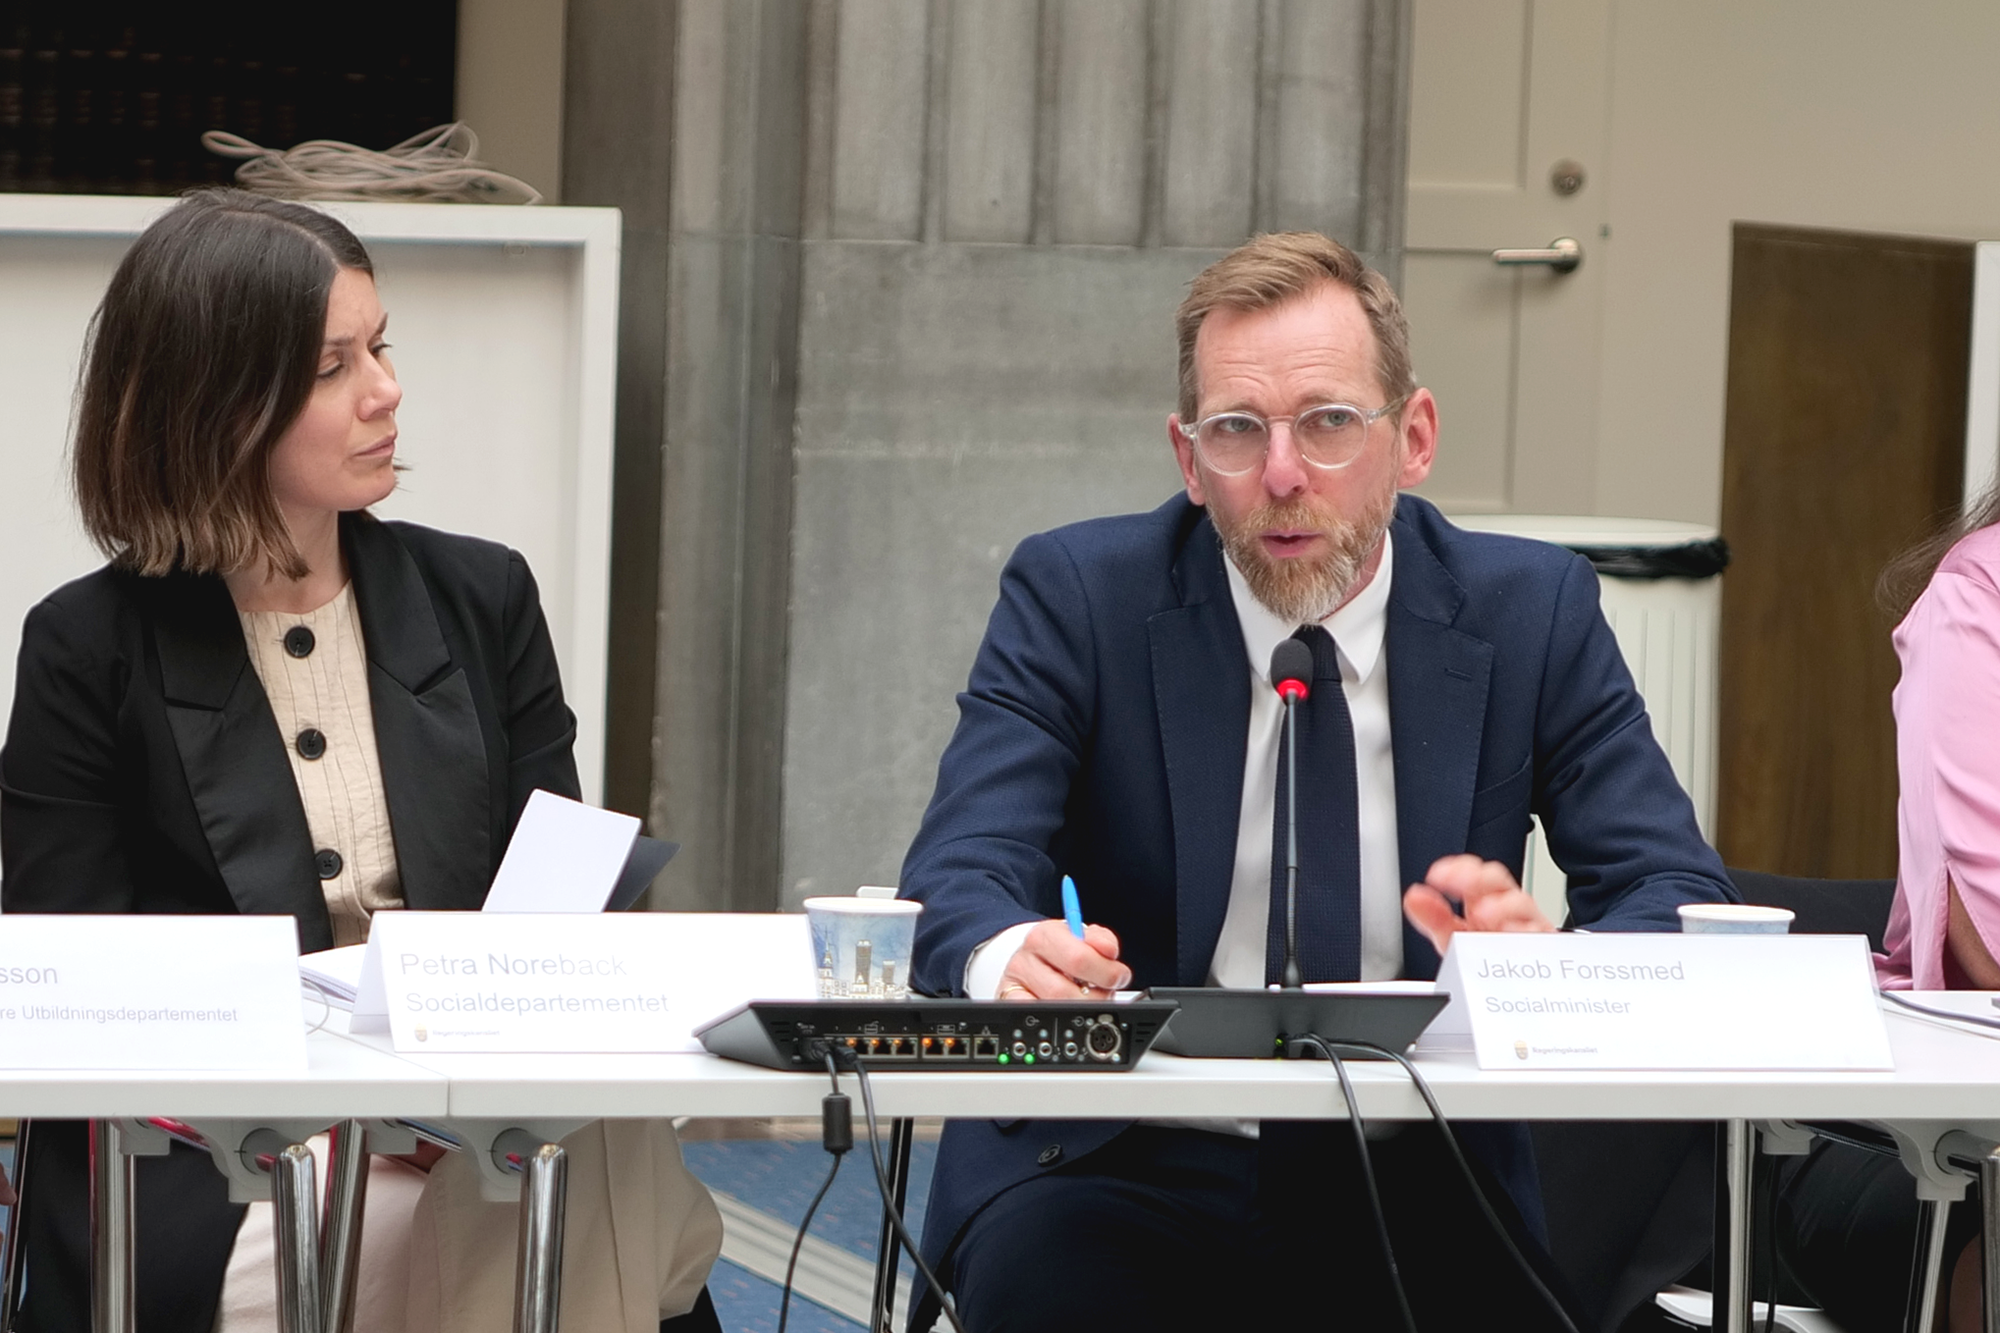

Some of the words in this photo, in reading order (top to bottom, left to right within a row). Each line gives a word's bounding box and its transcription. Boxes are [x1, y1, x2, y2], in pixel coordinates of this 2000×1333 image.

[400, 953, 478, 975] Petra
[488, 953, 628, 976] Noreback
[1477, 958, 1552, 979] Jakob
[1560, 959, 1685, 980] Forssmed
[0, 967, 58, 984] sson
[0, 1008, 16, 1020] re
[22, 1004, 238, 1023] Utbildningsdepartementet
[406, 992, 670, 1016] Socialdepartementet
[1485, 997, 1631, 1014] Socialminister
